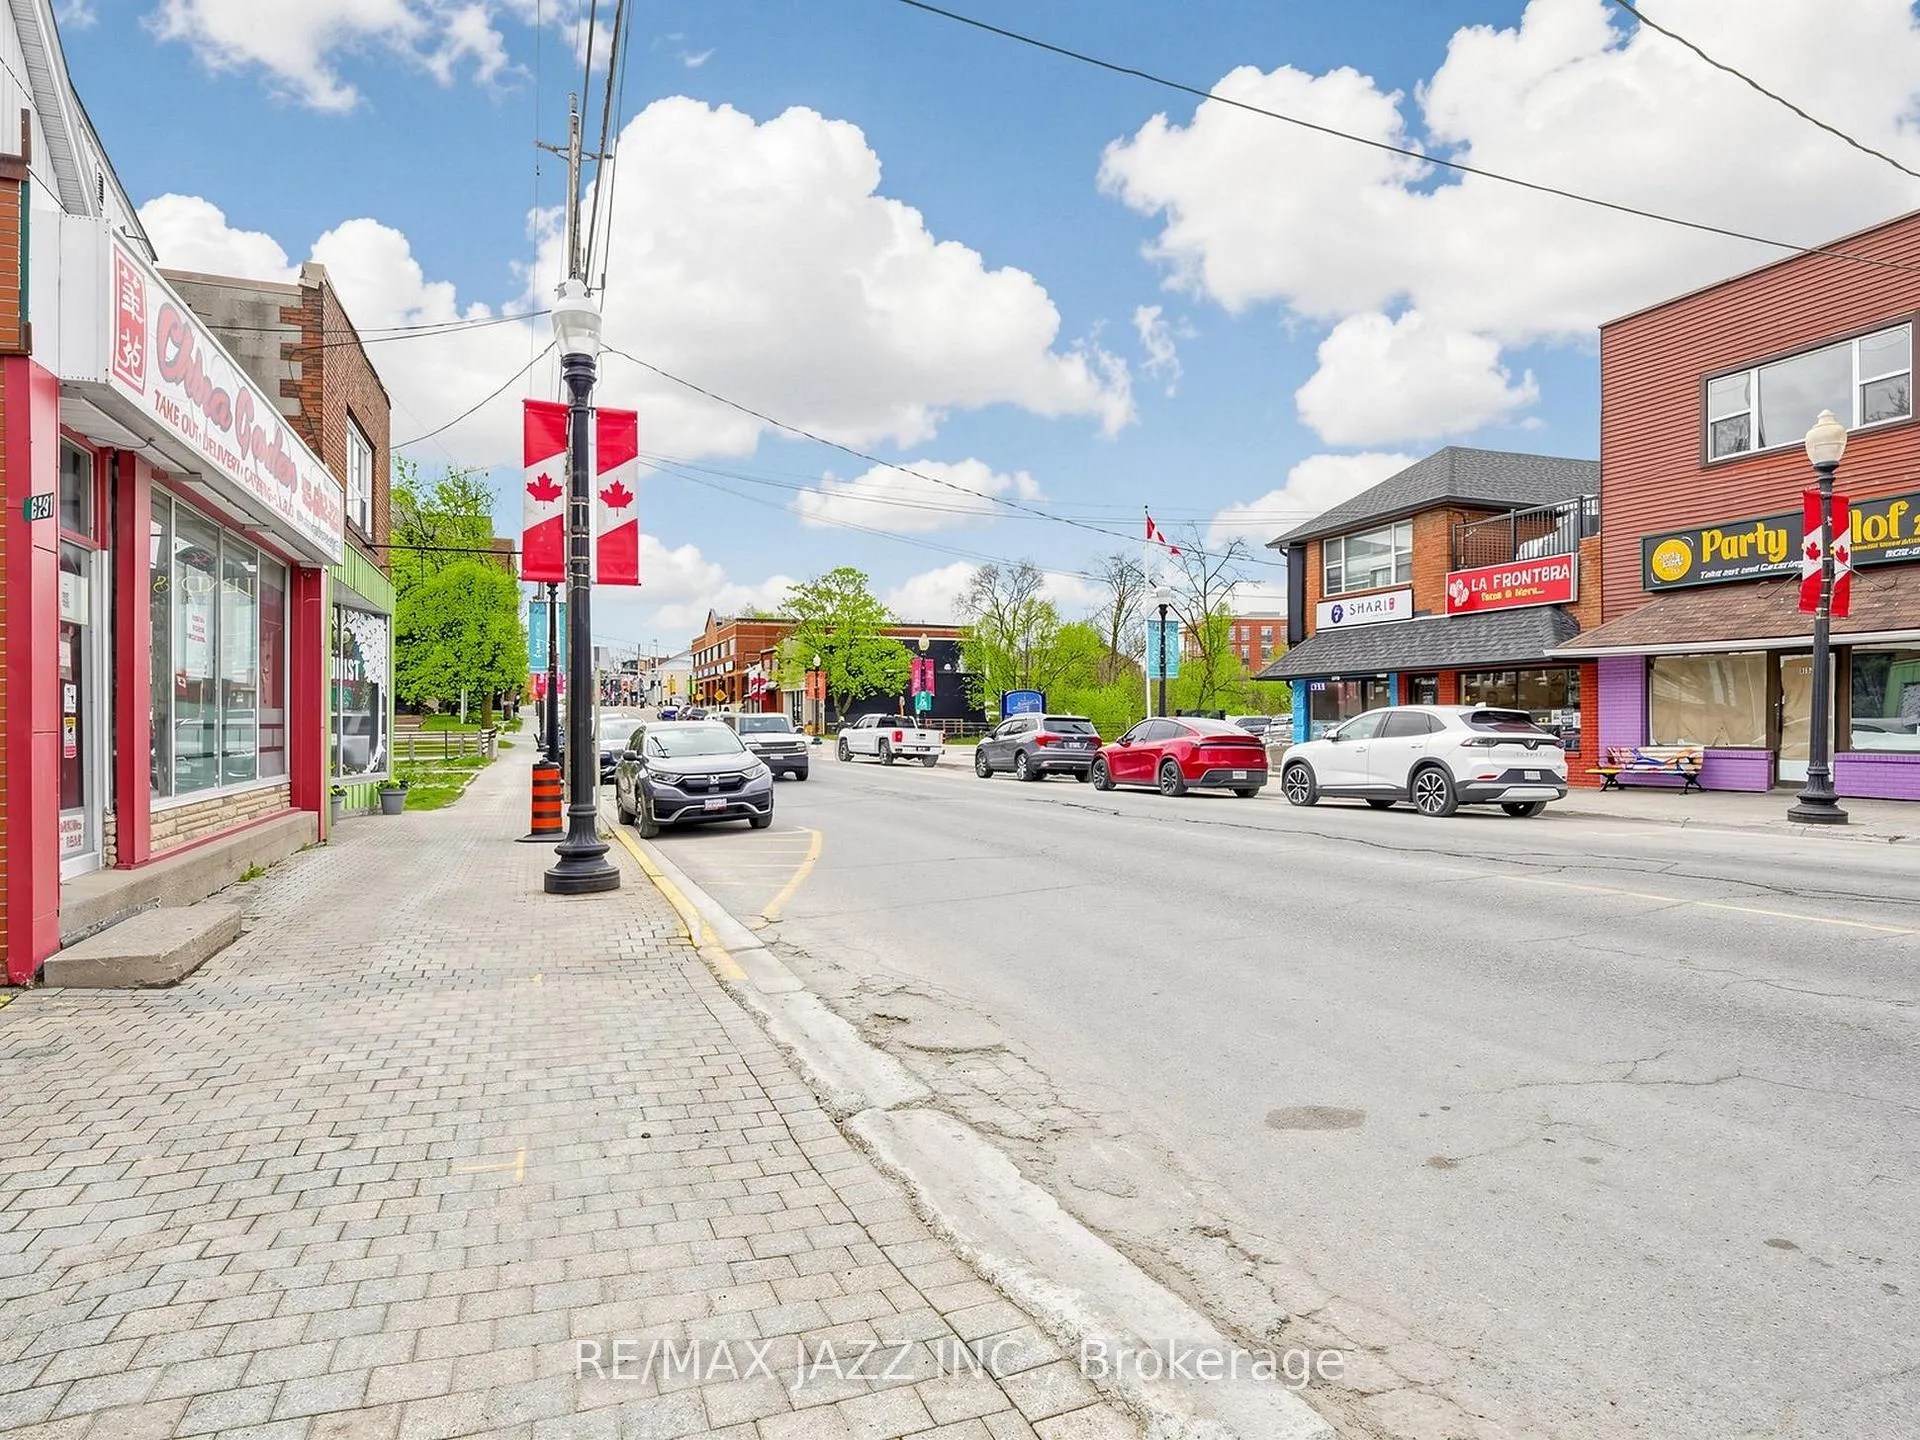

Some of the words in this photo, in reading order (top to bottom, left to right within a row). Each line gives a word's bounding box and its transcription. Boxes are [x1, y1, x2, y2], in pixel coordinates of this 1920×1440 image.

[154, 389, 180, 428] TAKE
[181, 414, 200, 443] OUT
[1701, 521, 1788, 563] Party
[1471, 577, 1488, 592] LA
[1493, 563, 1570, 589] FRONTERA
[1700, 569, 1722, 579] Take
[1722, 567, 1739, 577] out
[1740, 564, 1759, 574] and
